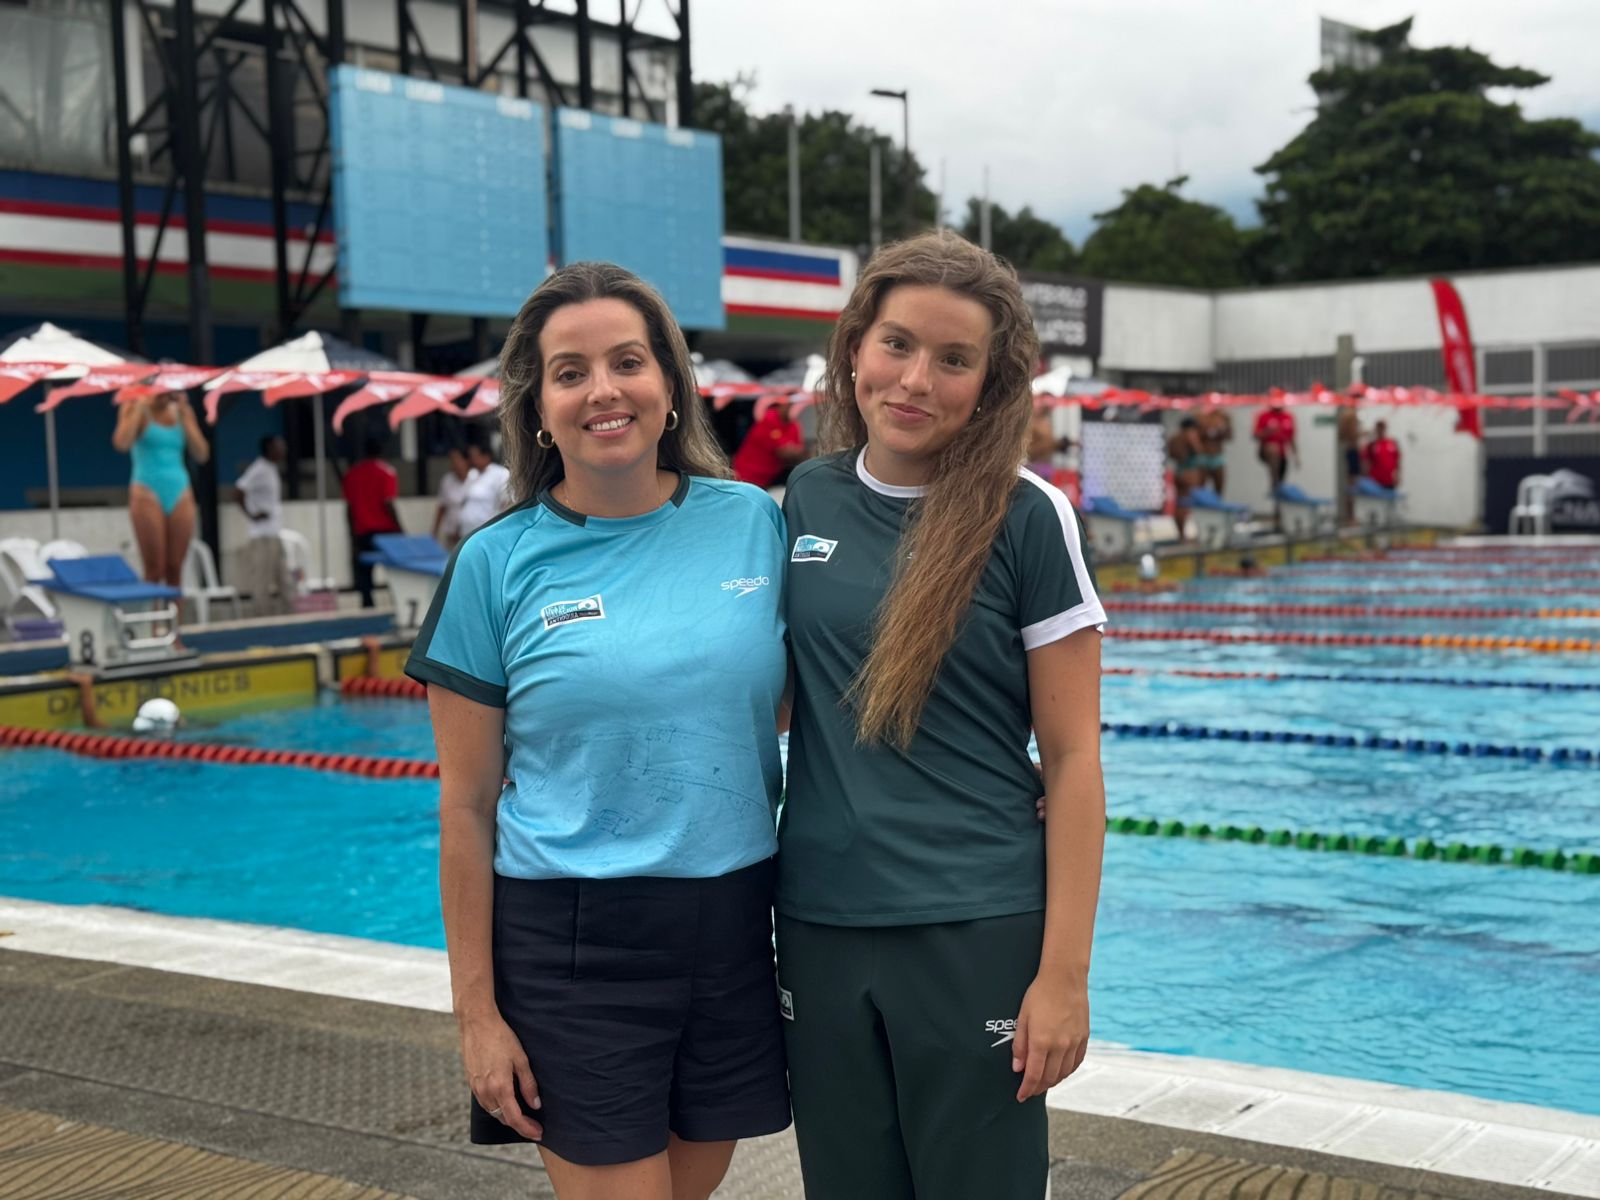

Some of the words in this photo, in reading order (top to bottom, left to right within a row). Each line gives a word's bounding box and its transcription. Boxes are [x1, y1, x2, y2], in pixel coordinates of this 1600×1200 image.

[720, 575, 770, 591] speedo
[80, 630, 94, 664] 8
[48, 671, 251, 715] DKTRONICS
